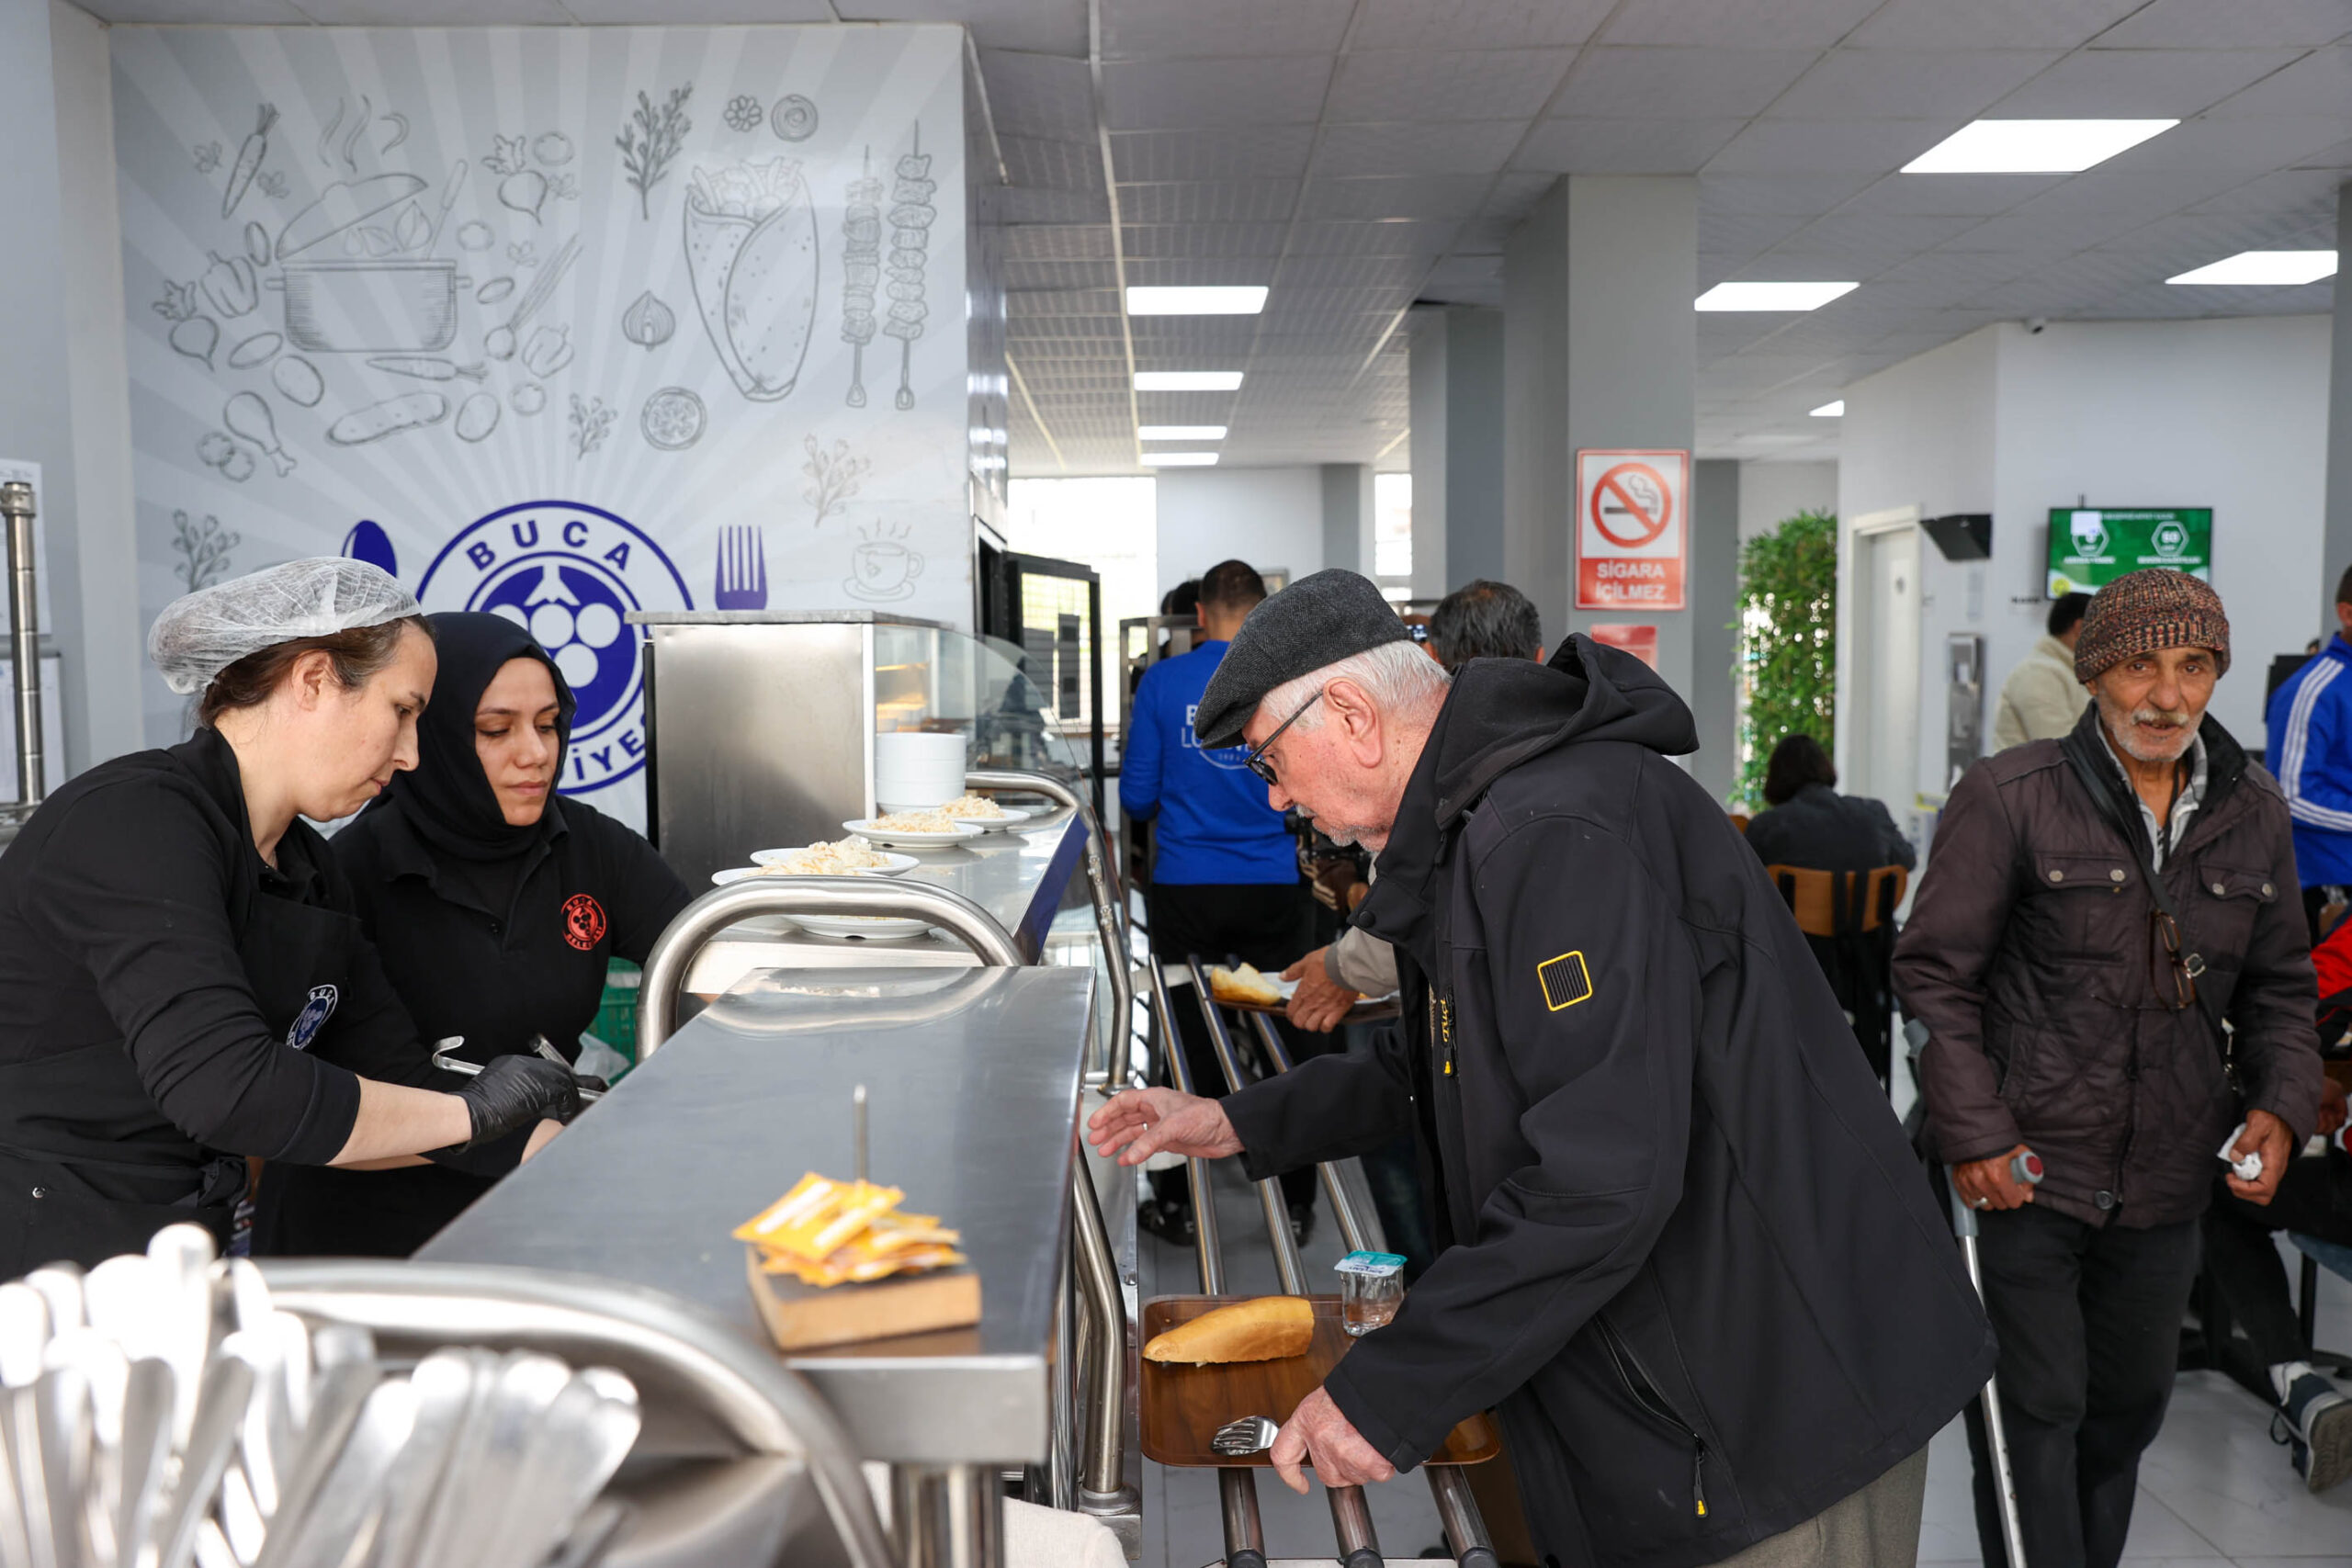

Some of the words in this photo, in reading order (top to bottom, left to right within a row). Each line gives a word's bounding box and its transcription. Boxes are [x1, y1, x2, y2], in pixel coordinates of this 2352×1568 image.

[466, 520, 631, 571] BUCA
[1597, 558, 1665, 579] SİGARA
[1596, 581, 1666, 603] İÇİLMEZ
